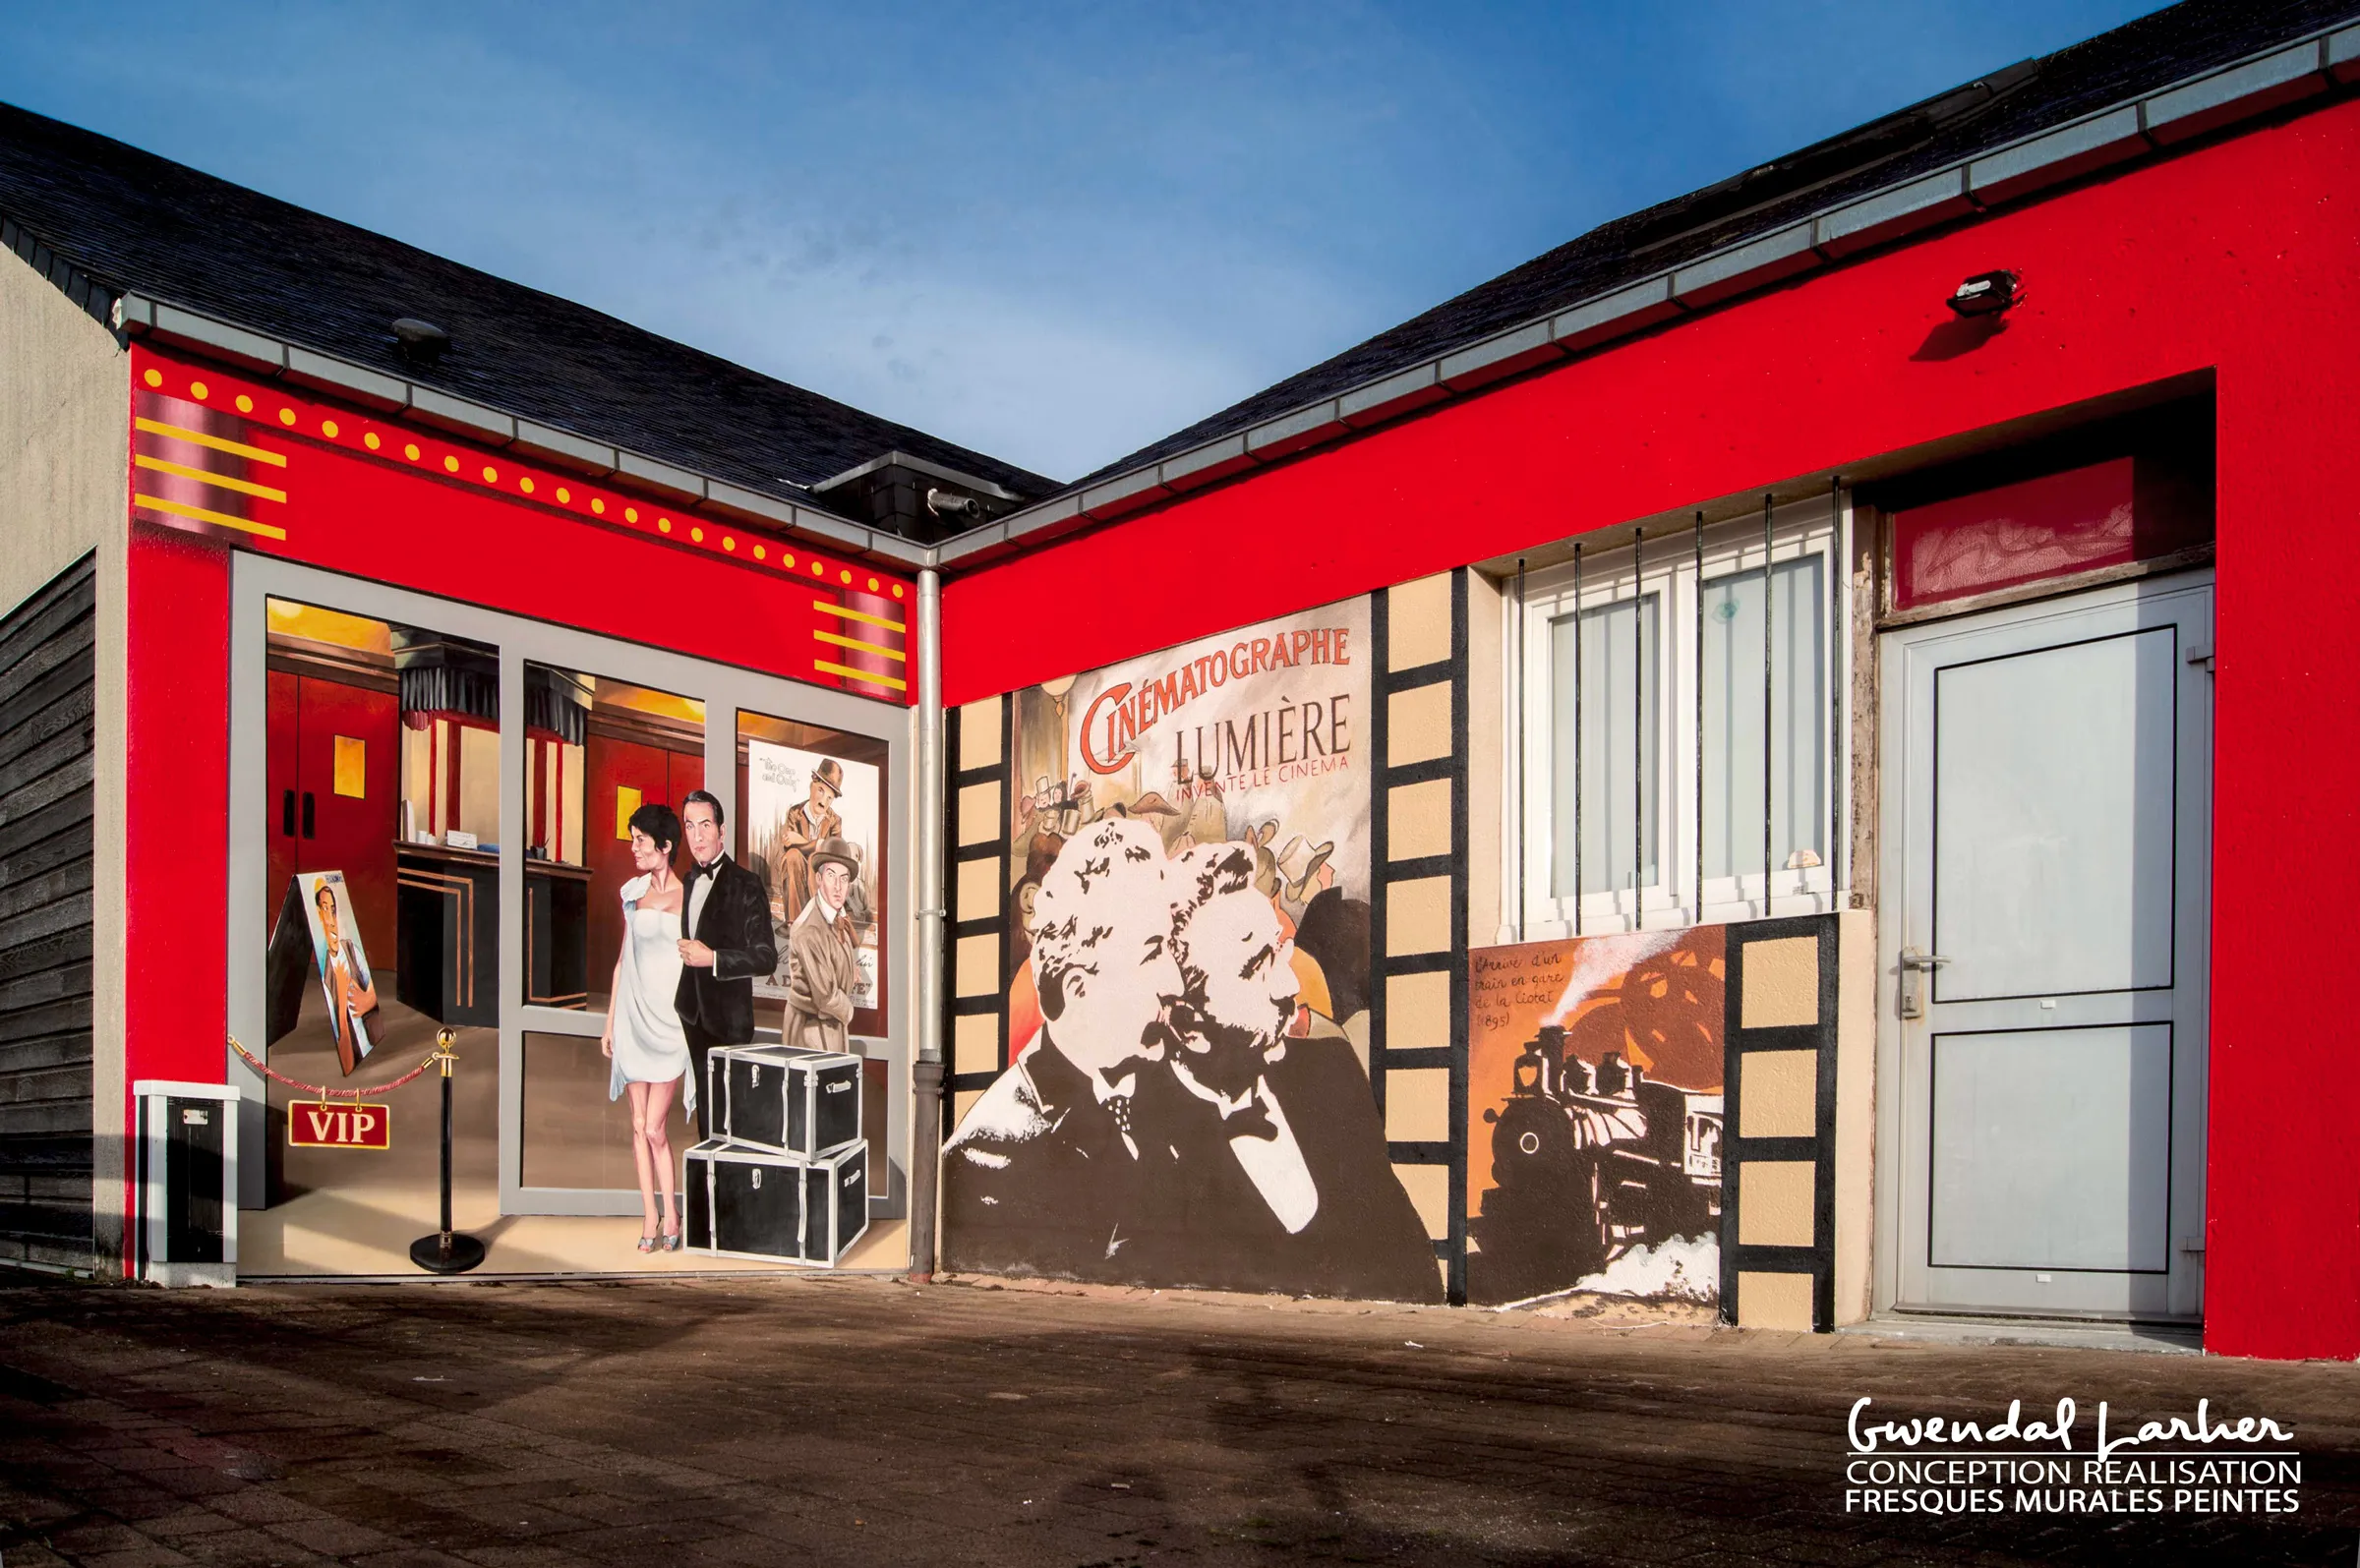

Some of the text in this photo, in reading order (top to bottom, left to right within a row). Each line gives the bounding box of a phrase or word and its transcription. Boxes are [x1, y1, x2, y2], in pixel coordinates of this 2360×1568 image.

[1080, 627, 1350, 775] CINÉMATOGRAPHE
[1176, 693, 1351, 785] LUMIÈRE
[1176, 755, 1349, 802] INVENTE LE CINEMA
[1496, 992, 1510, 1008] la
[307, 1111, 376, 1143] VIP
